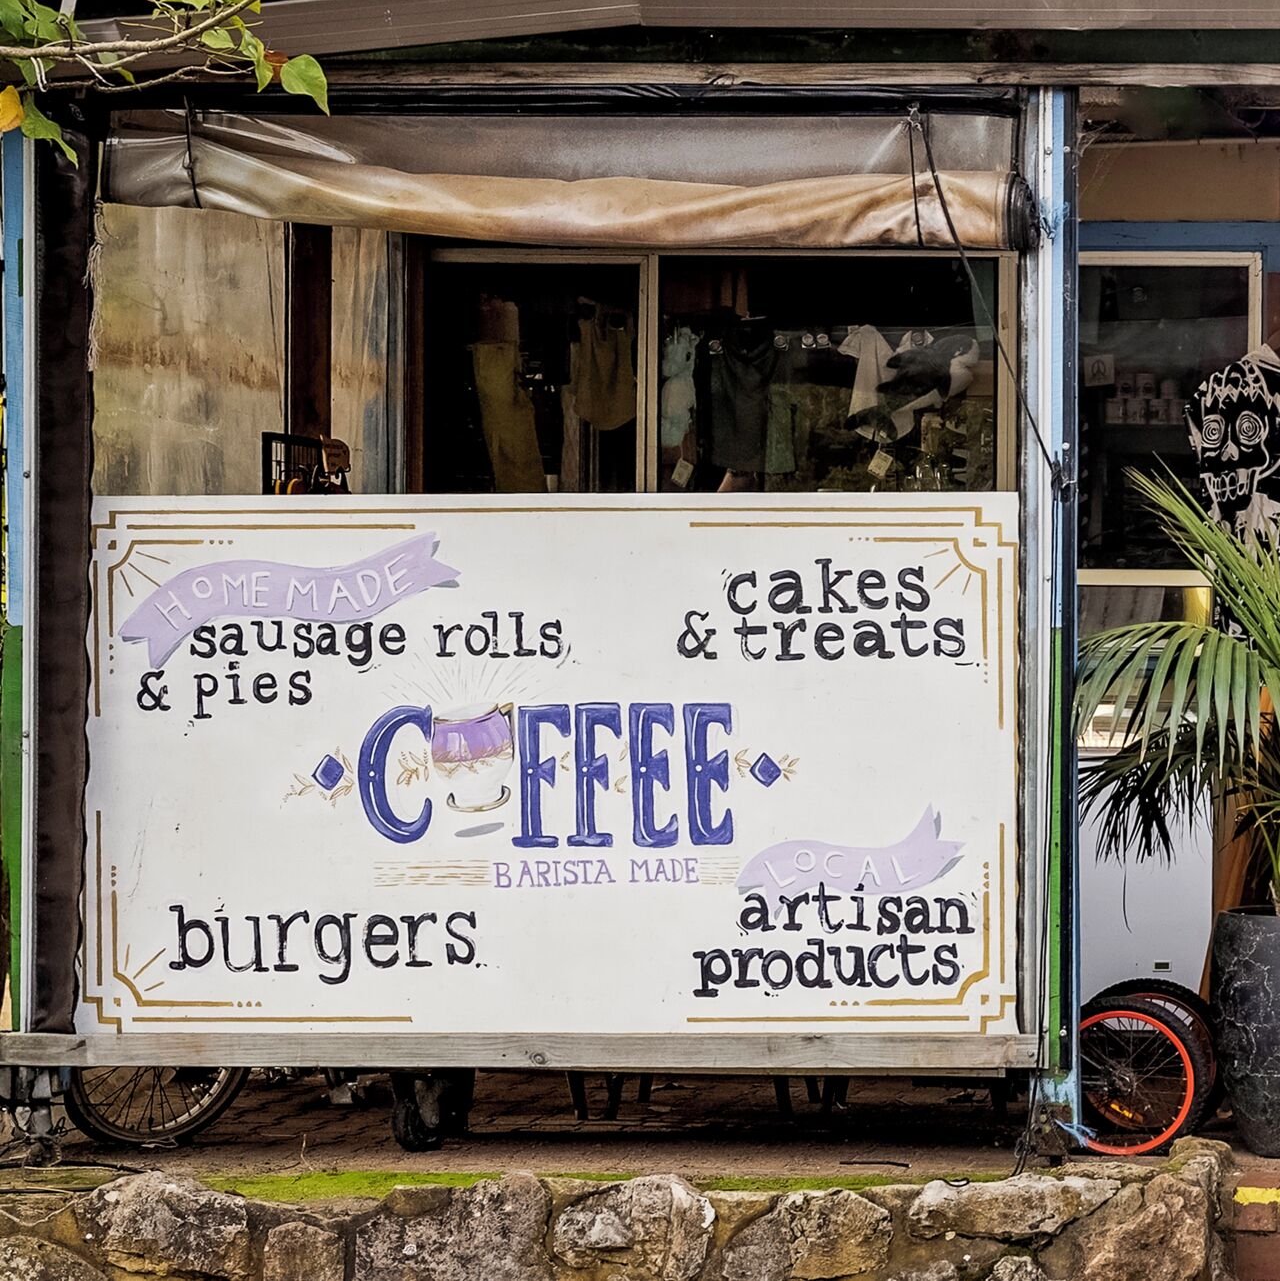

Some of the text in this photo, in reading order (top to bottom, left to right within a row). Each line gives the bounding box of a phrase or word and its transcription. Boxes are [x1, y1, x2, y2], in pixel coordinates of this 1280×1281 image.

[727, 558, 931, 615] cakes
[190, 620, 407, 666] sausage
[677, 610, 966, 662] & treats
[136, 661, 313, 719] & pies
[356, 701, 734, 848] CFFEE
[493, 857, 700, 889] BARISTA MADE
[762, 849, 922, 887] LOCAL
[740, 881, 975, 935] artisan
[168, 904, 478, 984] burgers
[693, 935, 961, 997] products
